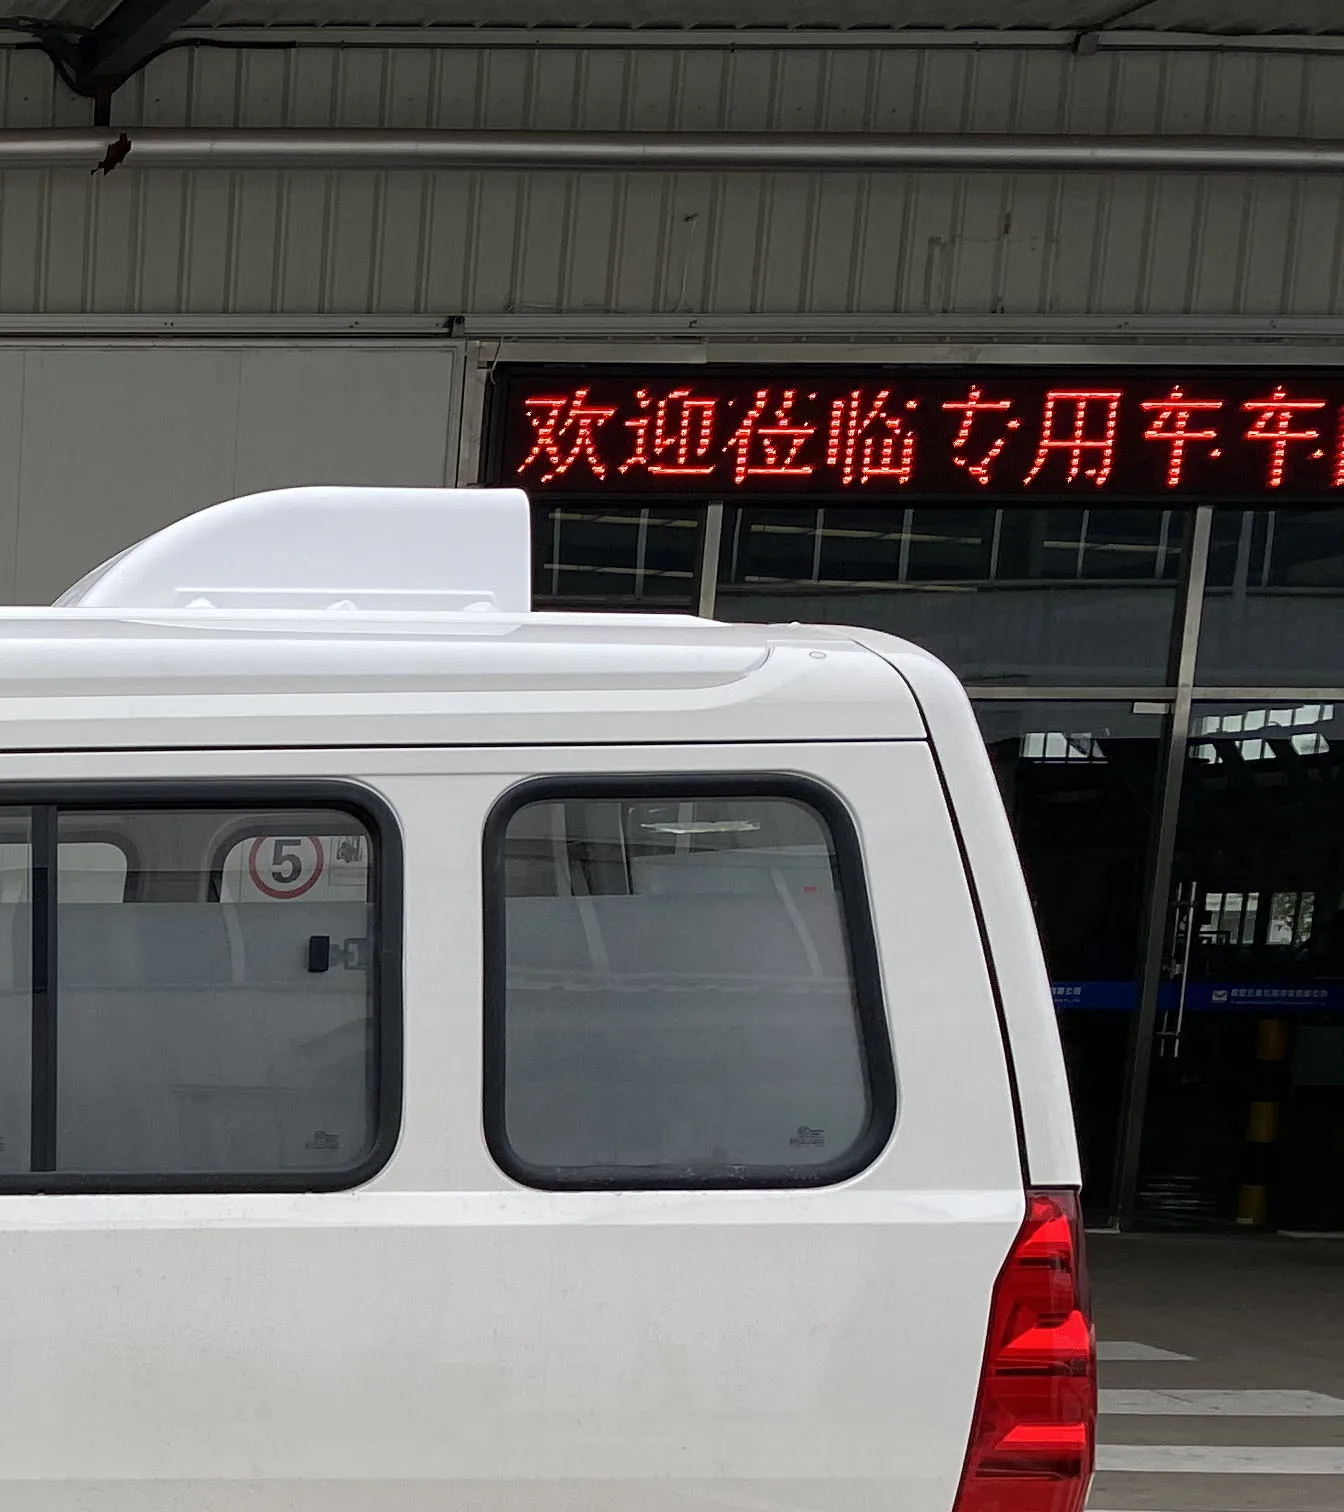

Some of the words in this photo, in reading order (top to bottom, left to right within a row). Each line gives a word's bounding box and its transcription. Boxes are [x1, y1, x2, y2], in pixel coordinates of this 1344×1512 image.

[516, 384, 1344, 489] 欢迎莅临专用车车
[271, 839, 302, 884] 5
